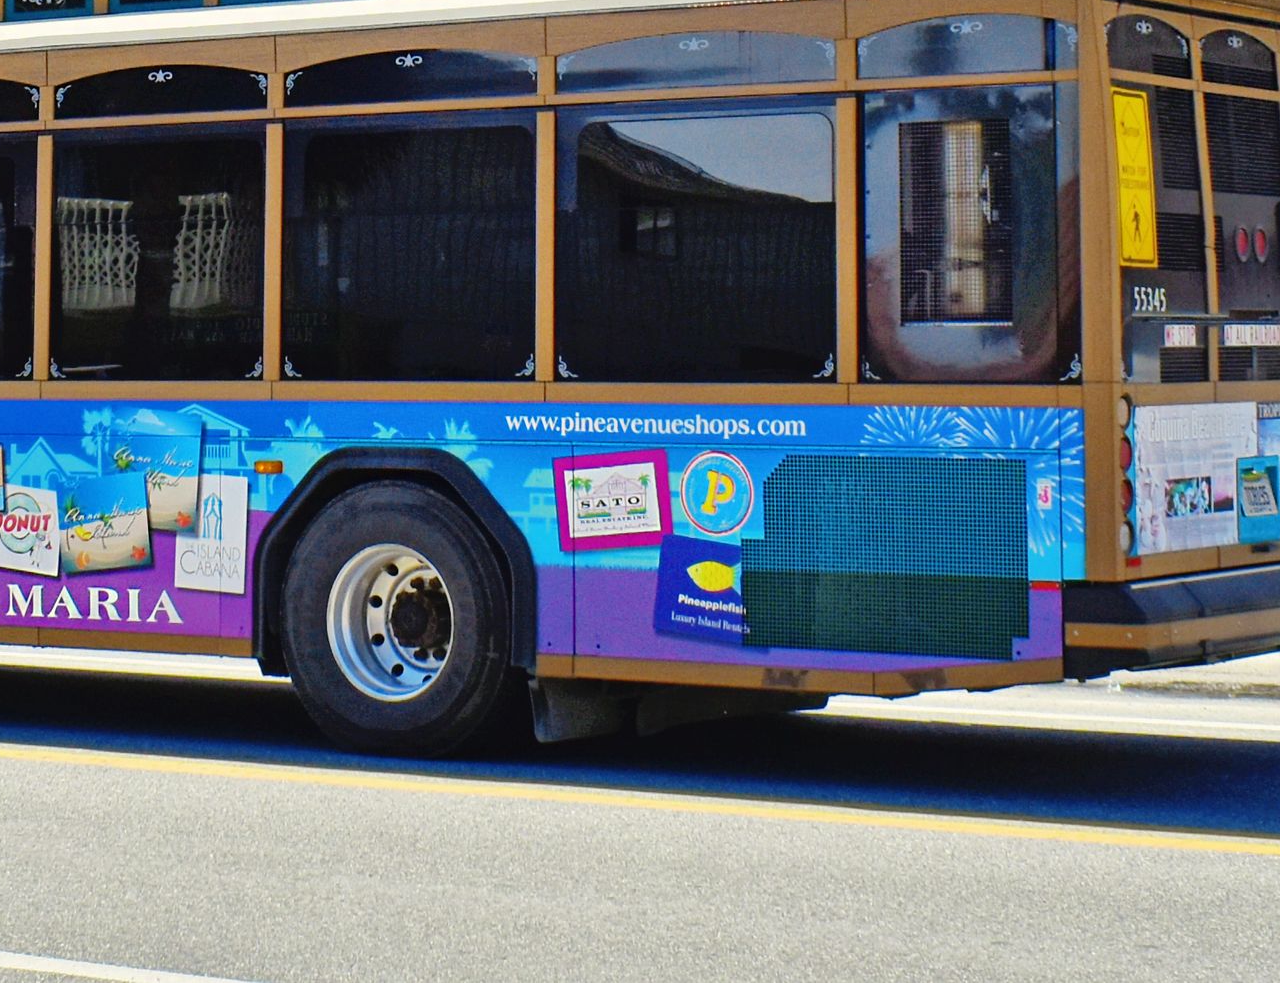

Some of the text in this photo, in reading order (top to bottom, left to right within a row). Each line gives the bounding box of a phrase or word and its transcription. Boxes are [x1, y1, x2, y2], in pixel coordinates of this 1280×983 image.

[1133, 286, 1166, 312] 55345
[505, 412, 806, 439] www.pineavenueshops.com
[580, 496, 641, 510] SATO
[701, 469, 736, 516] P
[179, 549, 240, 578] CABANA
[195, 543, 241, 561] ISLAND
[6, 584, 184, 624] MARIA
[671, 610, 696, 625] Luxury
[697, 615, 722, 629] Island
